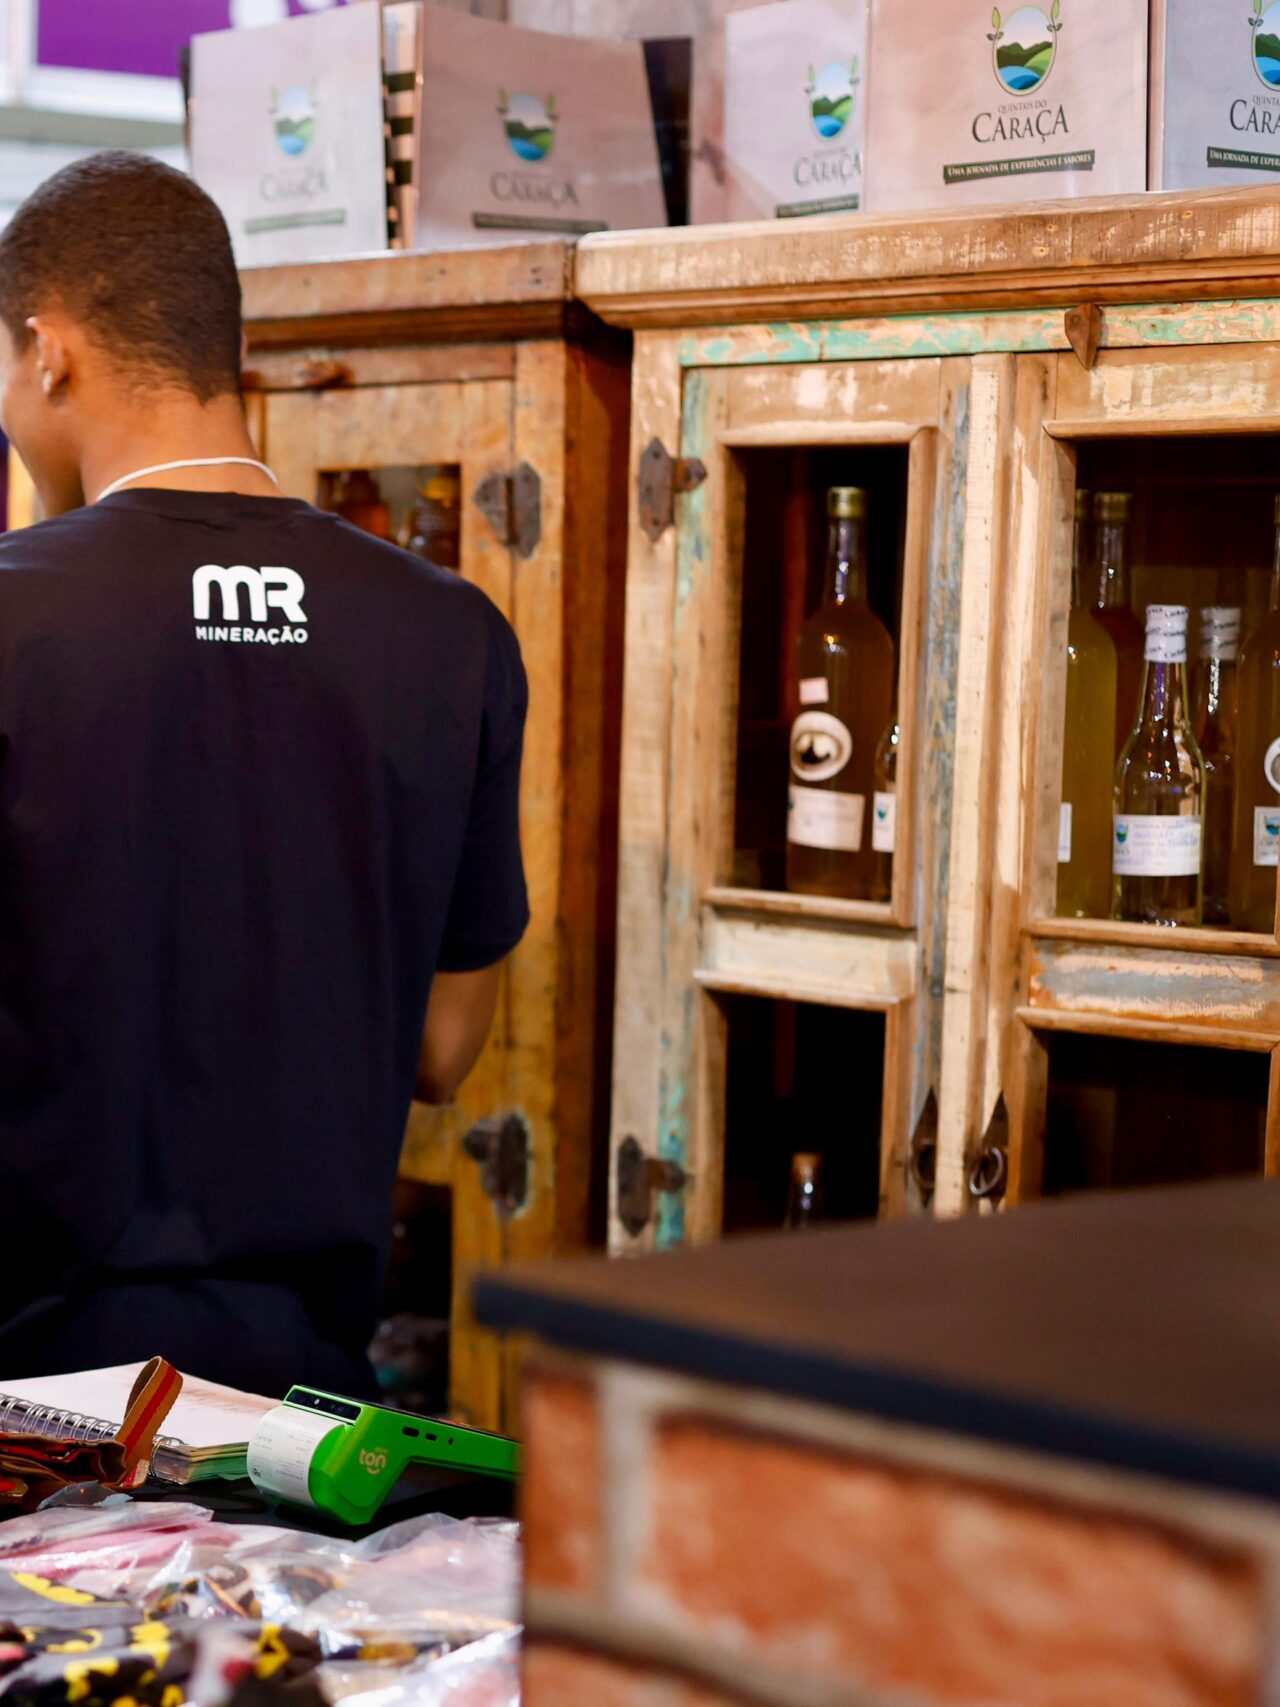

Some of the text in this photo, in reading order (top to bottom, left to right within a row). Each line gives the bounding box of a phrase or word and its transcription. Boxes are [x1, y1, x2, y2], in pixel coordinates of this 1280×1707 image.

[971, 104, 1069, 144] CARAÇA
[1260, 158, 1280, 168] EXPER
[195, 625, 308, 645] MINERAÇÃO
